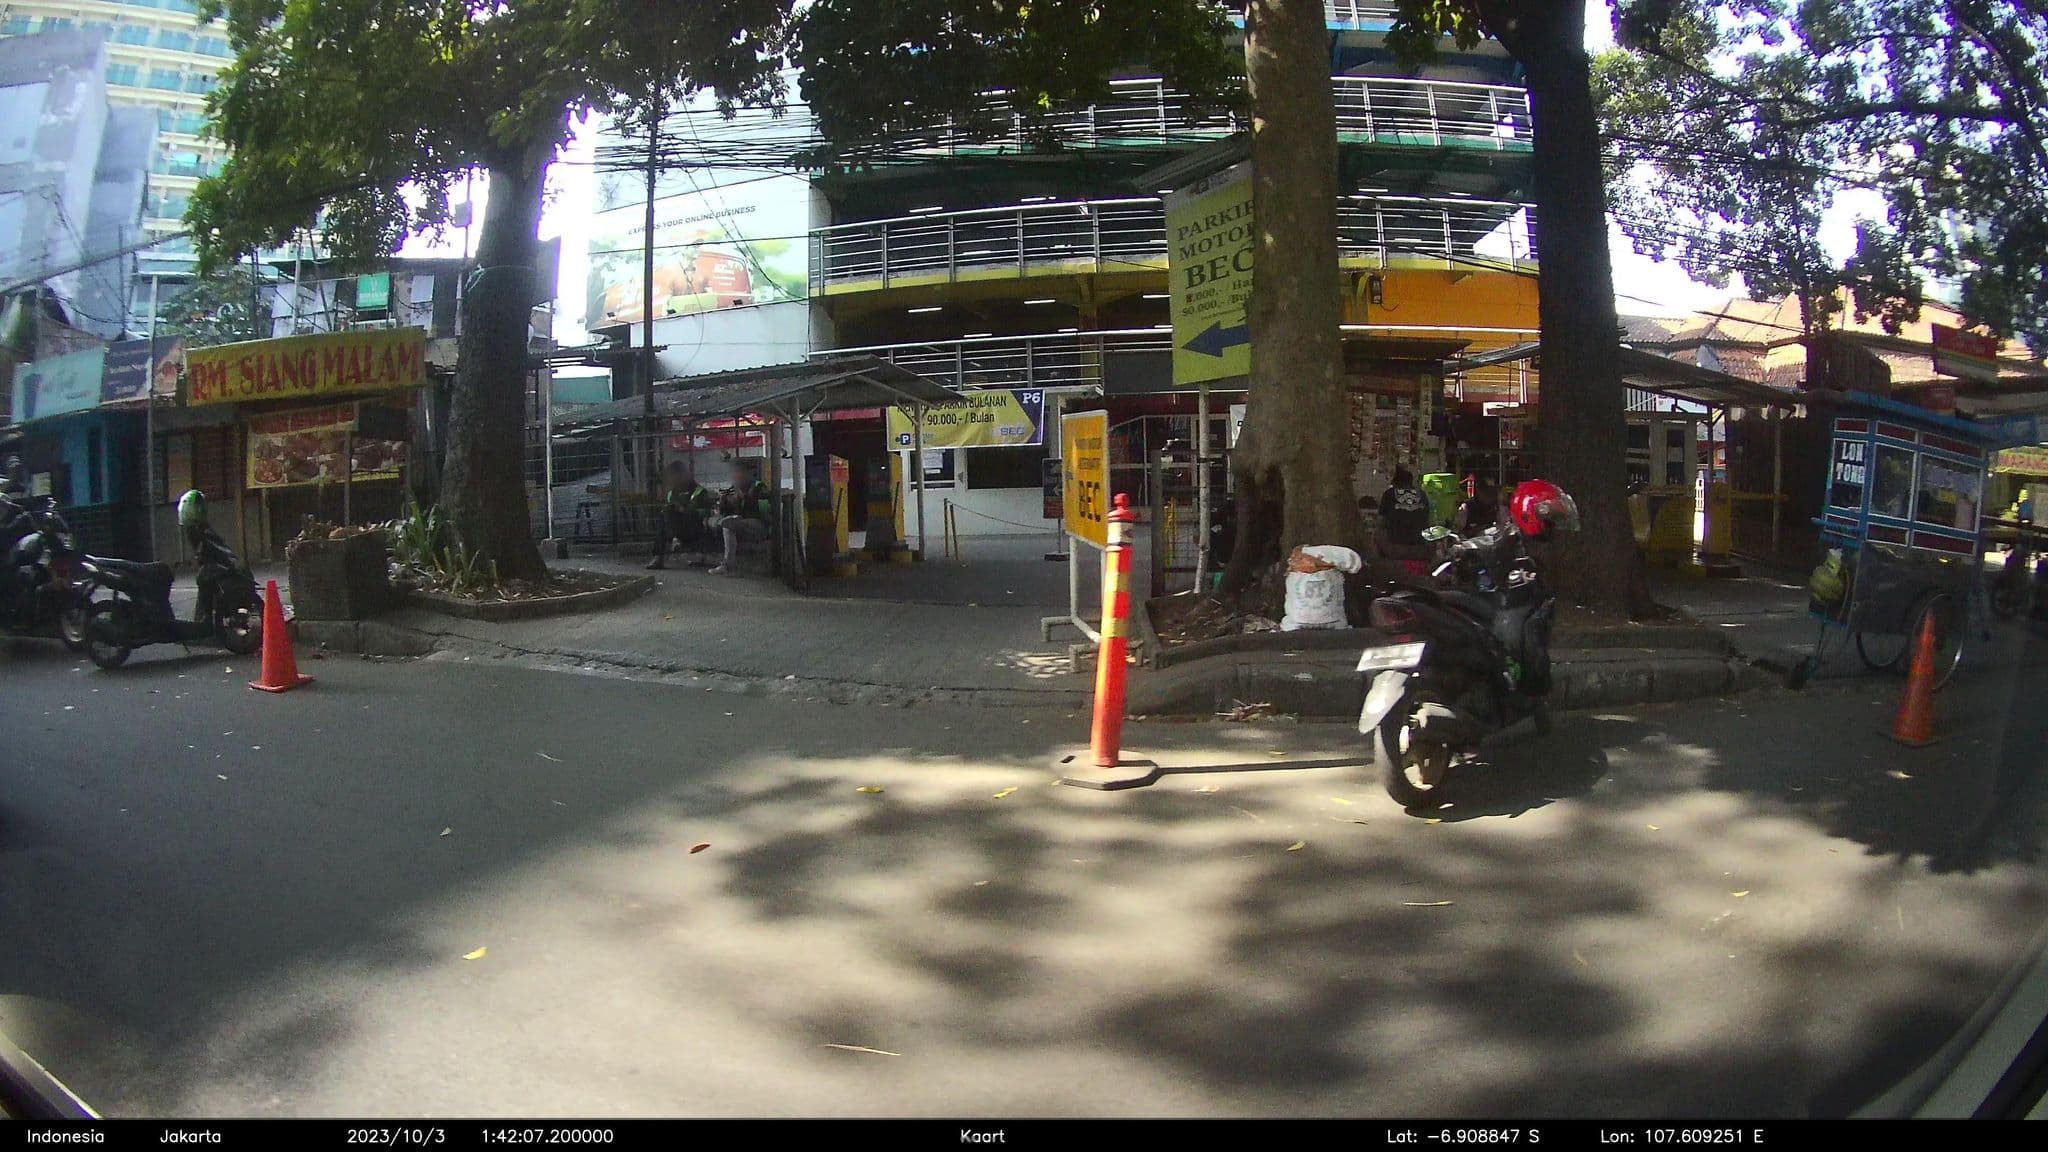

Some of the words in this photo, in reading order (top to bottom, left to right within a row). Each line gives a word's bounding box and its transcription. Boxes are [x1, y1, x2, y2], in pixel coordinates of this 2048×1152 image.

[662, 218, 684, 228] YOUR
[685, 211, 714, 224] ONLINE
[715, 205, 756, 219] BUSINESS
[1184, 246, 1254, 290] BEC
[190, 360, 233, 401] RM.
[239, 347, 317, 394] SIANG
[323, 341, 419, 387] MALAM
[969, 395, 1007, 409] BULANAN
[1022, 392, 1041, 404] P6
[927, 413, 962, 426] 90.000,-
[970, 412, 995, 424] Bulan
[1841, 442, 1864, 462] LON
[1078, 480, 1102, 522] BEC
